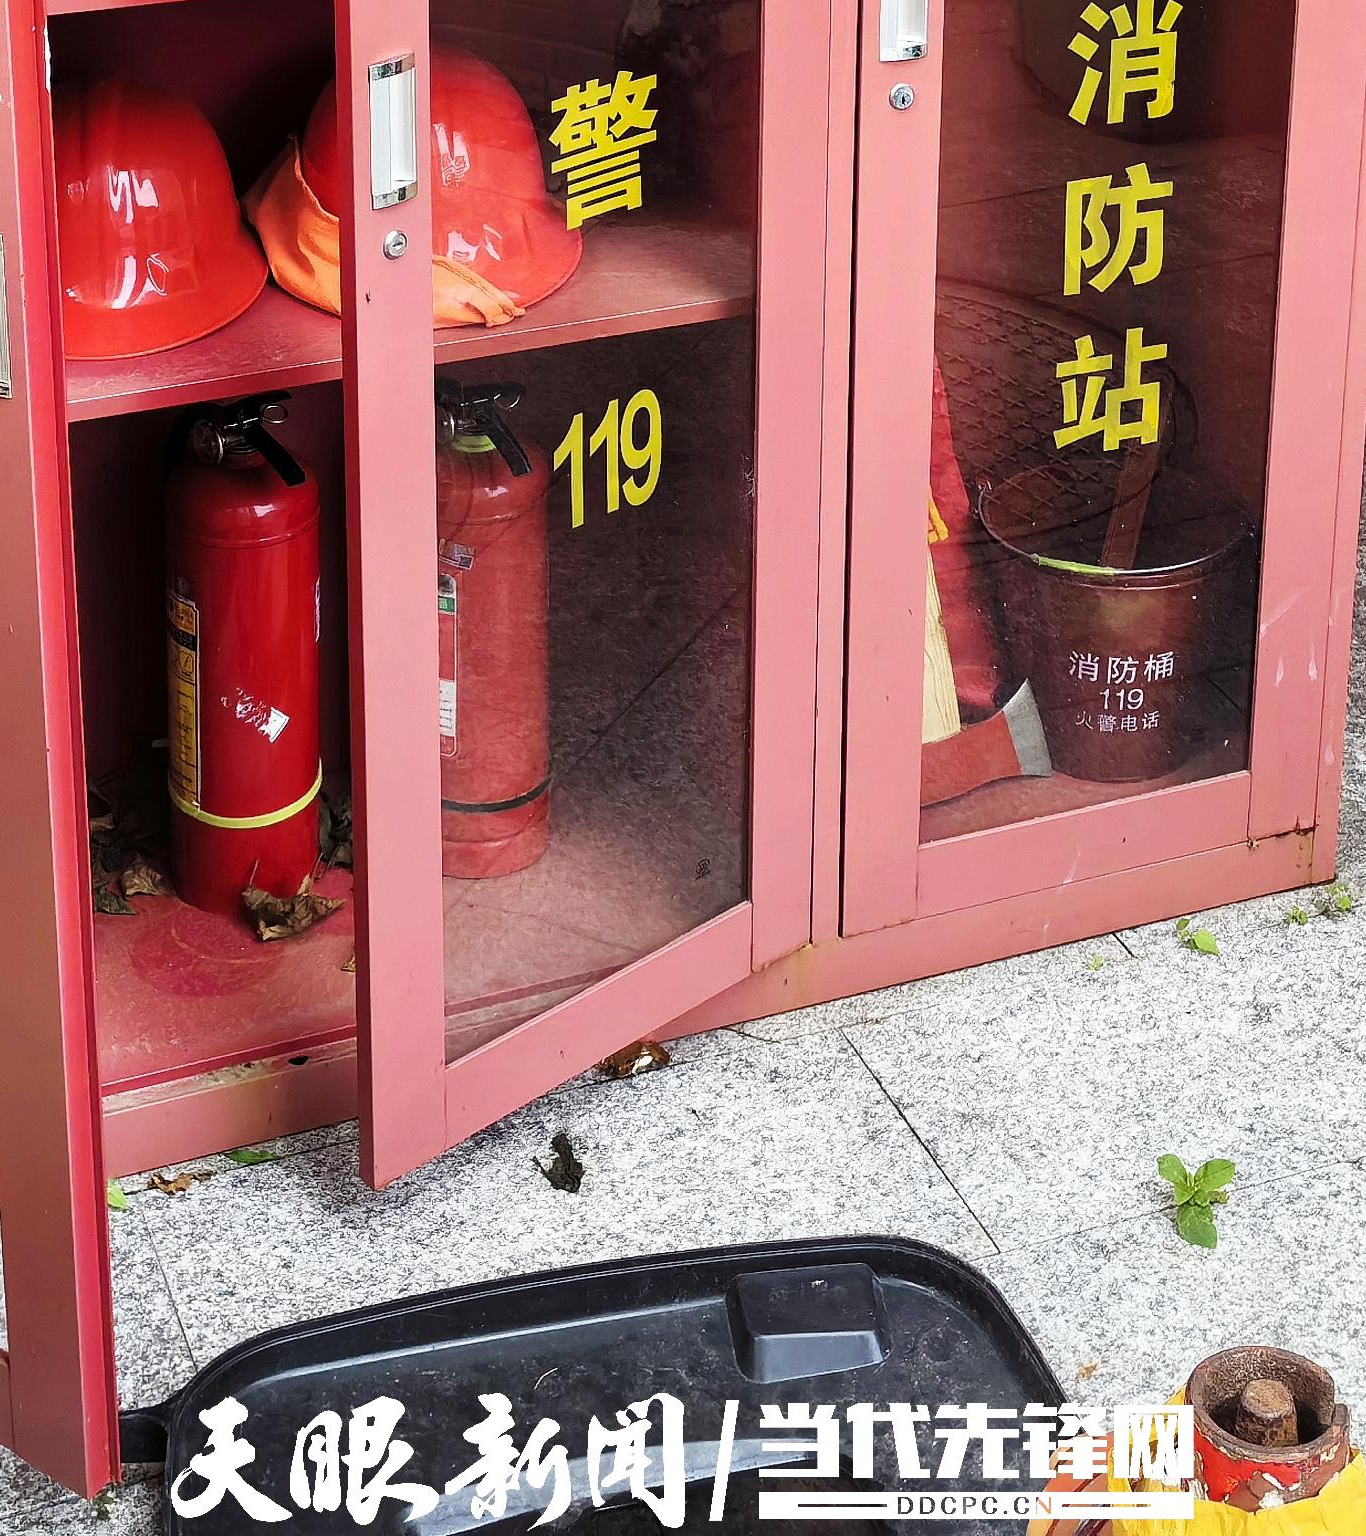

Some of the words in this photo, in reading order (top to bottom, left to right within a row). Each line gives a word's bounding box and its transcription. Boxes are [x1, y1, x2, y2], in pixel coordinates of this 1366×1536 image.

[553, 388, 663, 529] 119
[1069, 650, 1174, 685] 消防桶
[1099, 688, 1144, 711] 119
[1075, 710, 1160, 733] 火警电话
